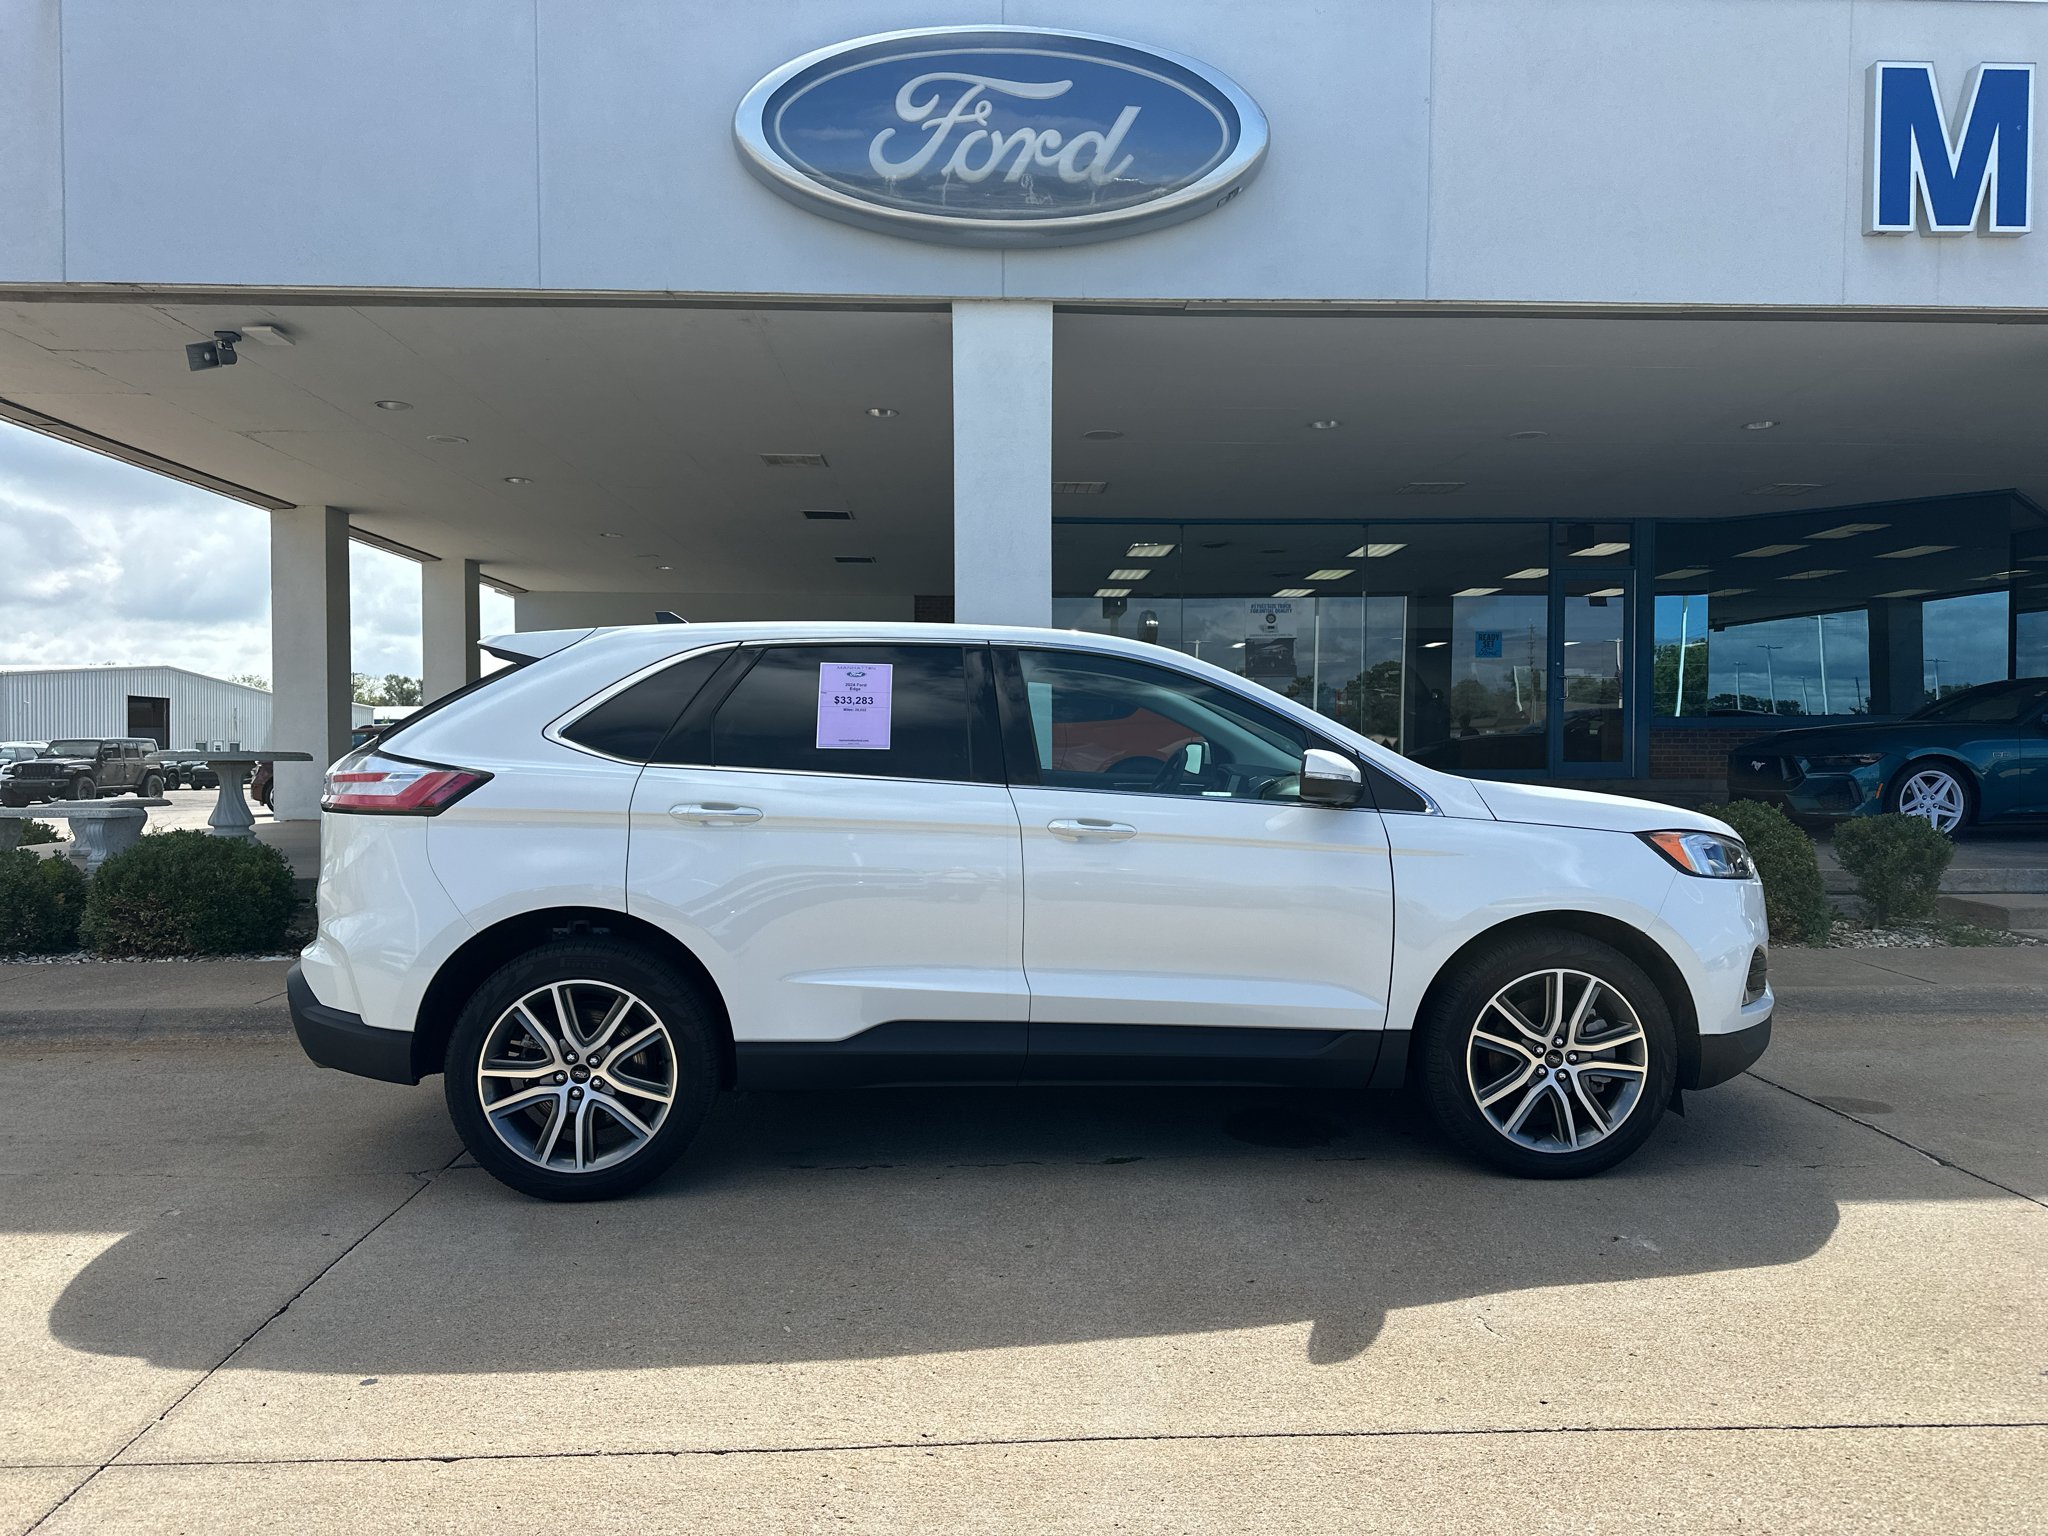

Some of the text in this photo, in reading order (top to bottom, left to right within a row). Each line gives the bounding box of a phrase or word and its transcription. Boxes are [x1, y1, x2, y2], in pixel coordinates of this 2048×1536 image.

[868, 71, 1142, 186] Ford
[1869, 60, 2037, 235] M
[834, 695, 874, 706] $33,283
